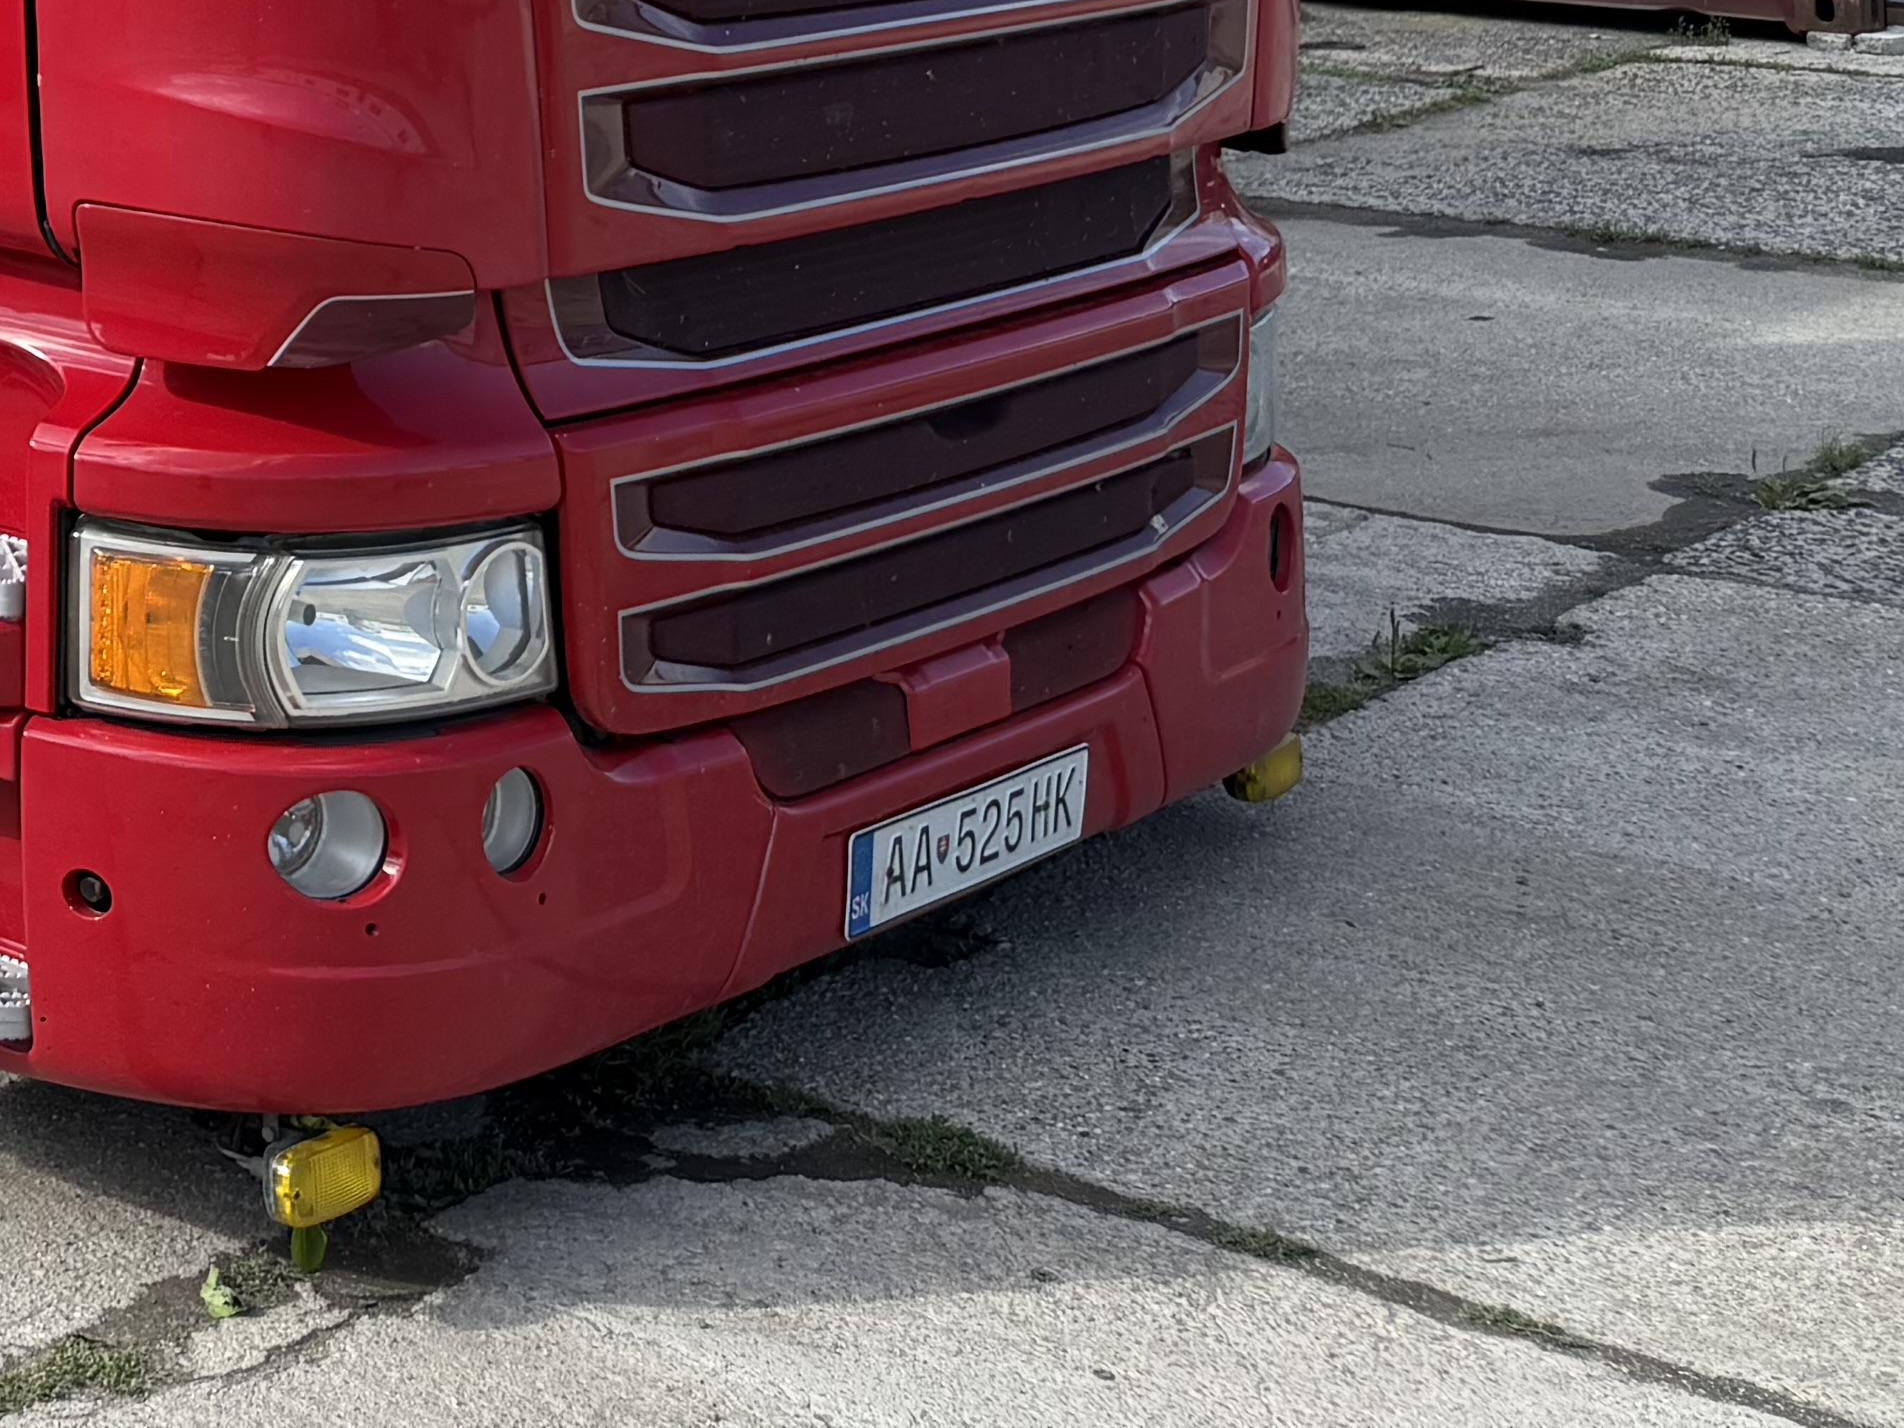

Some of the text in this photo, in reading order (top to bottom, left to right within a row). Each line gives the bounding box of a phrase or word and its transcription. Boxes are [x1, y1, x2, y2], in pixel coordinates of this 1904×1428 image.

[882, 765, 1077, 905] AA 525HK
[851, 890, 870, 921] SK
